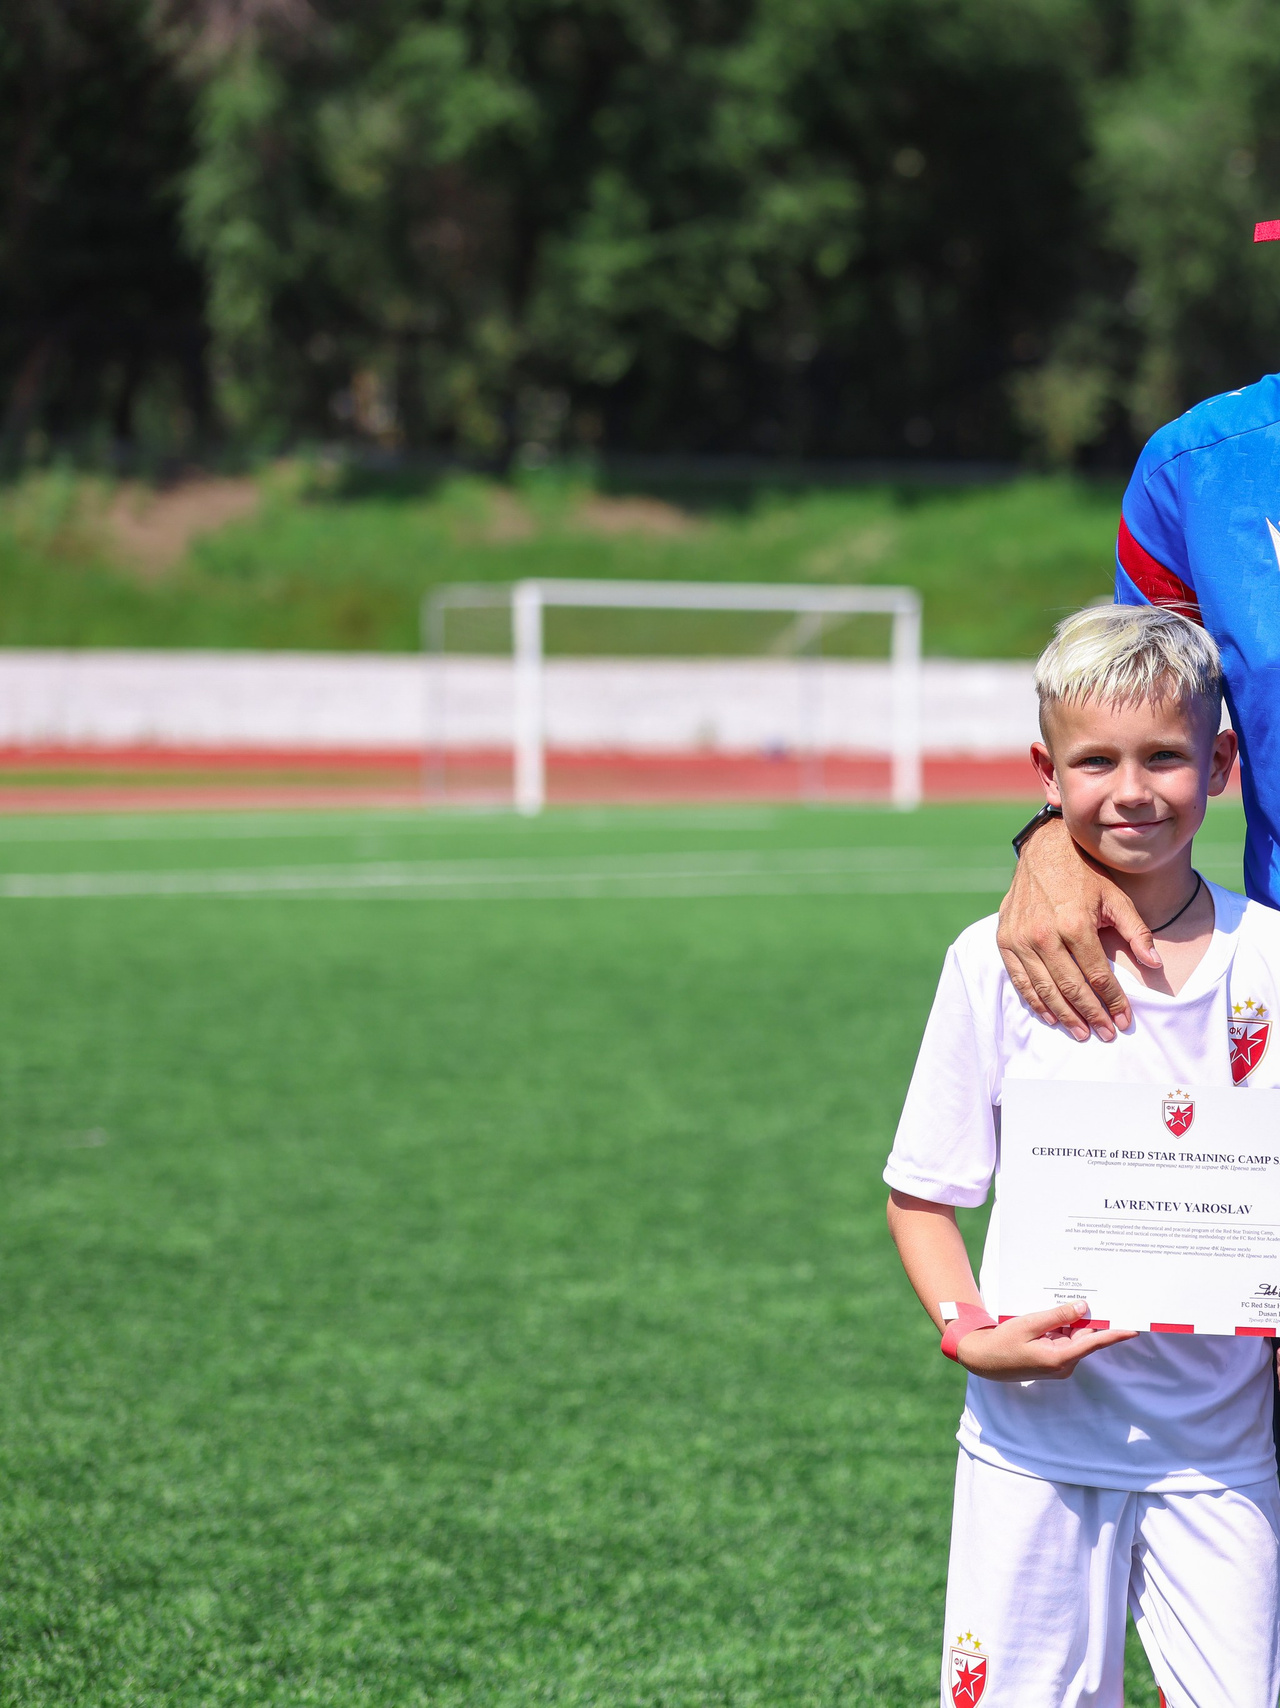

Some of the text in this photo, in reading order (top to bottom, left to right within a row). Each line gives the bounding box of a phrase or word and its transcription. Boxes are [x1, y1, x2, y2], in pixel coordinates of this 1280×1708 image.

[1229, 1027, 1242, 1035] ФК
[1032, 1147, 1107, 1158] CERTIFICATE
[1109, 1150, 1119, 1158] of
[1122, 1150, 1145, 1160] RED
[1147, 1151, 1176, 1161] STAR
[1179, 1152, 1235, 1163] TRAINING
[1238, 1155, 1271, 1165] CAMP
[1104, 1199, 1253, 1214] LAVRENTEV YAROSLAV
